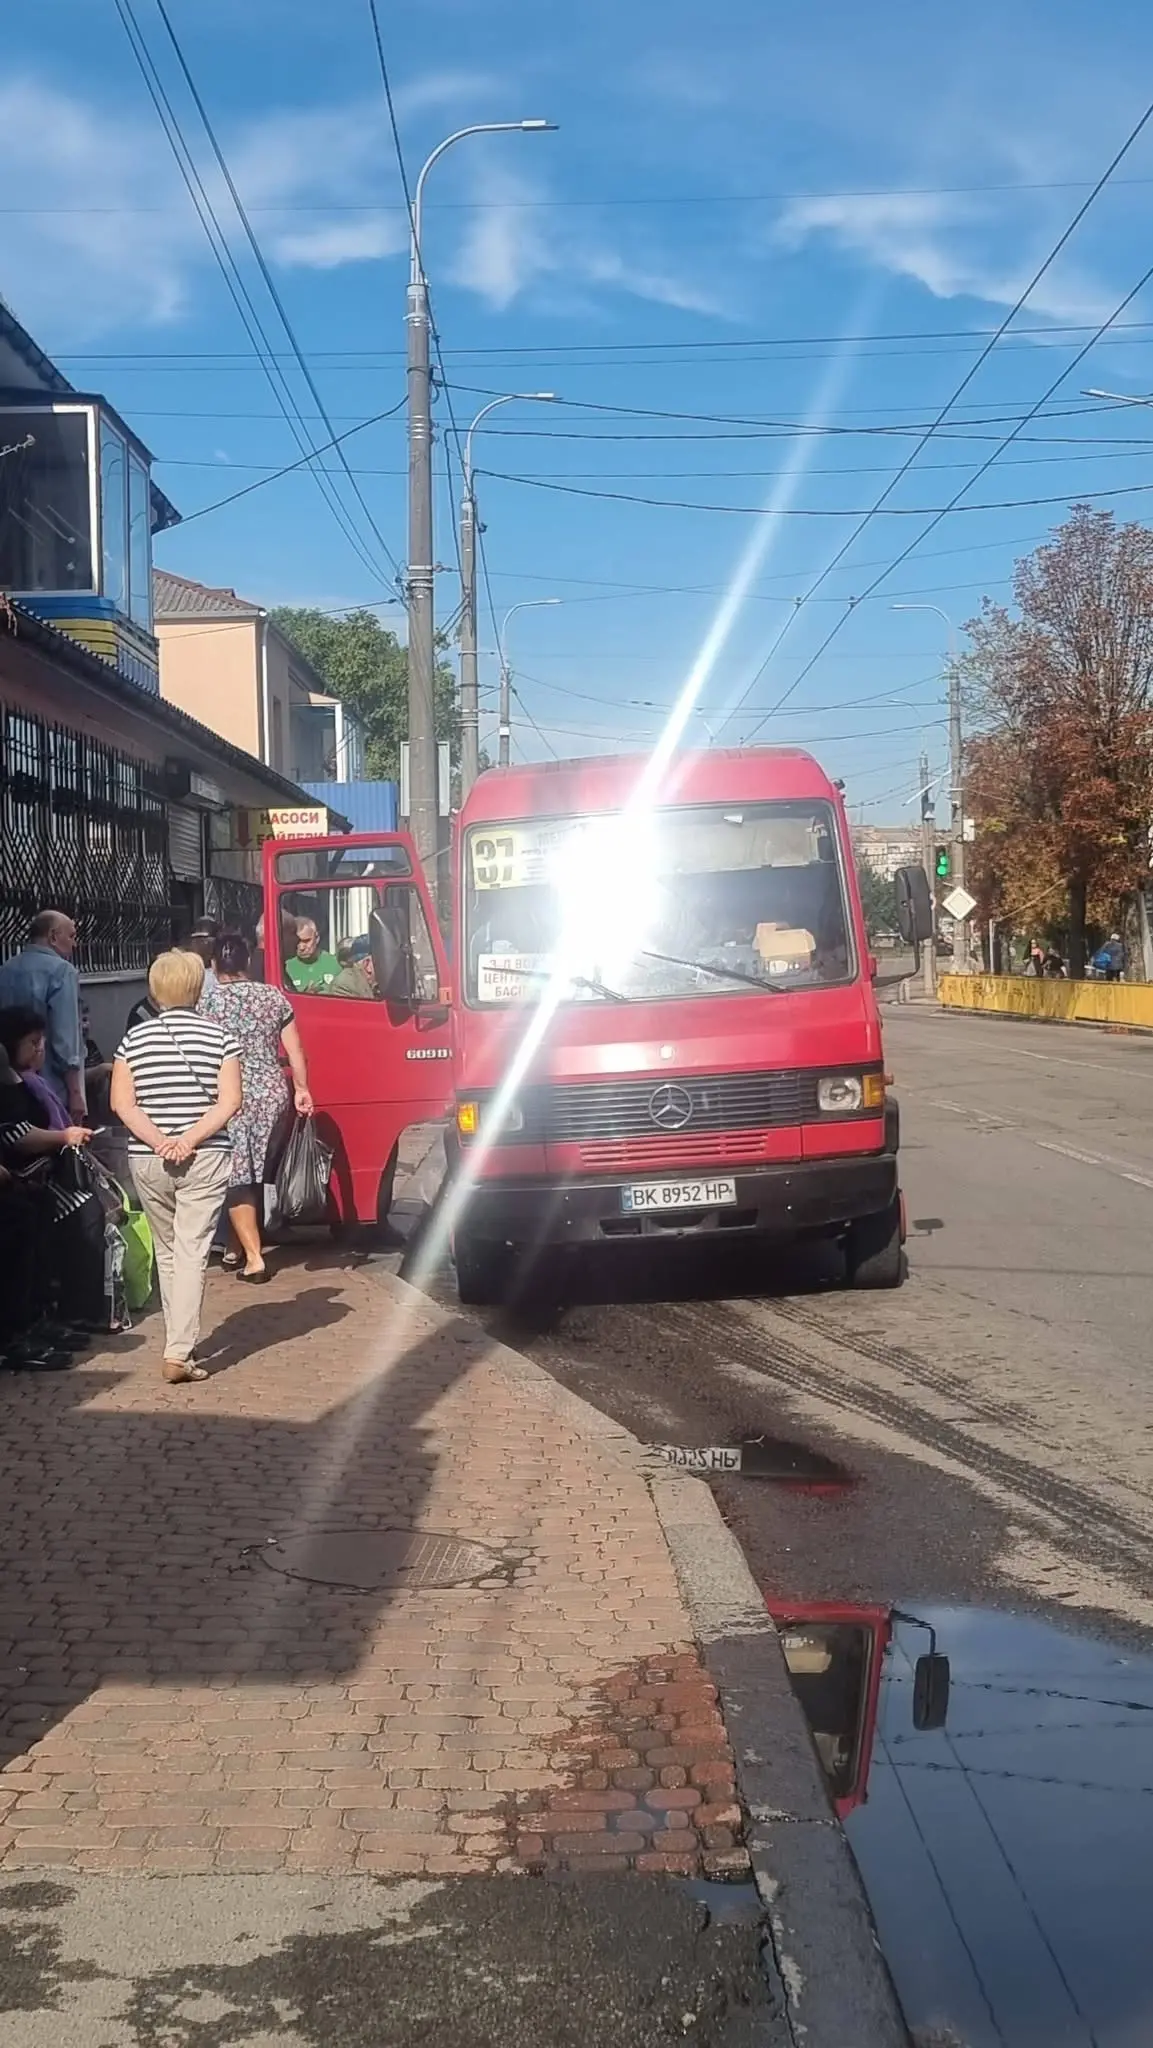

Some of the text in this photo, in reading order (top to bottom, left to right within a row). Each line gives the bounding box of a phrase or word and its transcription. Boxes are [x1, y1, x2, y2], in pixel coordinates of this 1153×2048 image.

[260, 811, 319, 825] НАСОСИ
[475, 837, 514, 884] 37
[633, 1182, 730, 1206] BK 8952 HP
